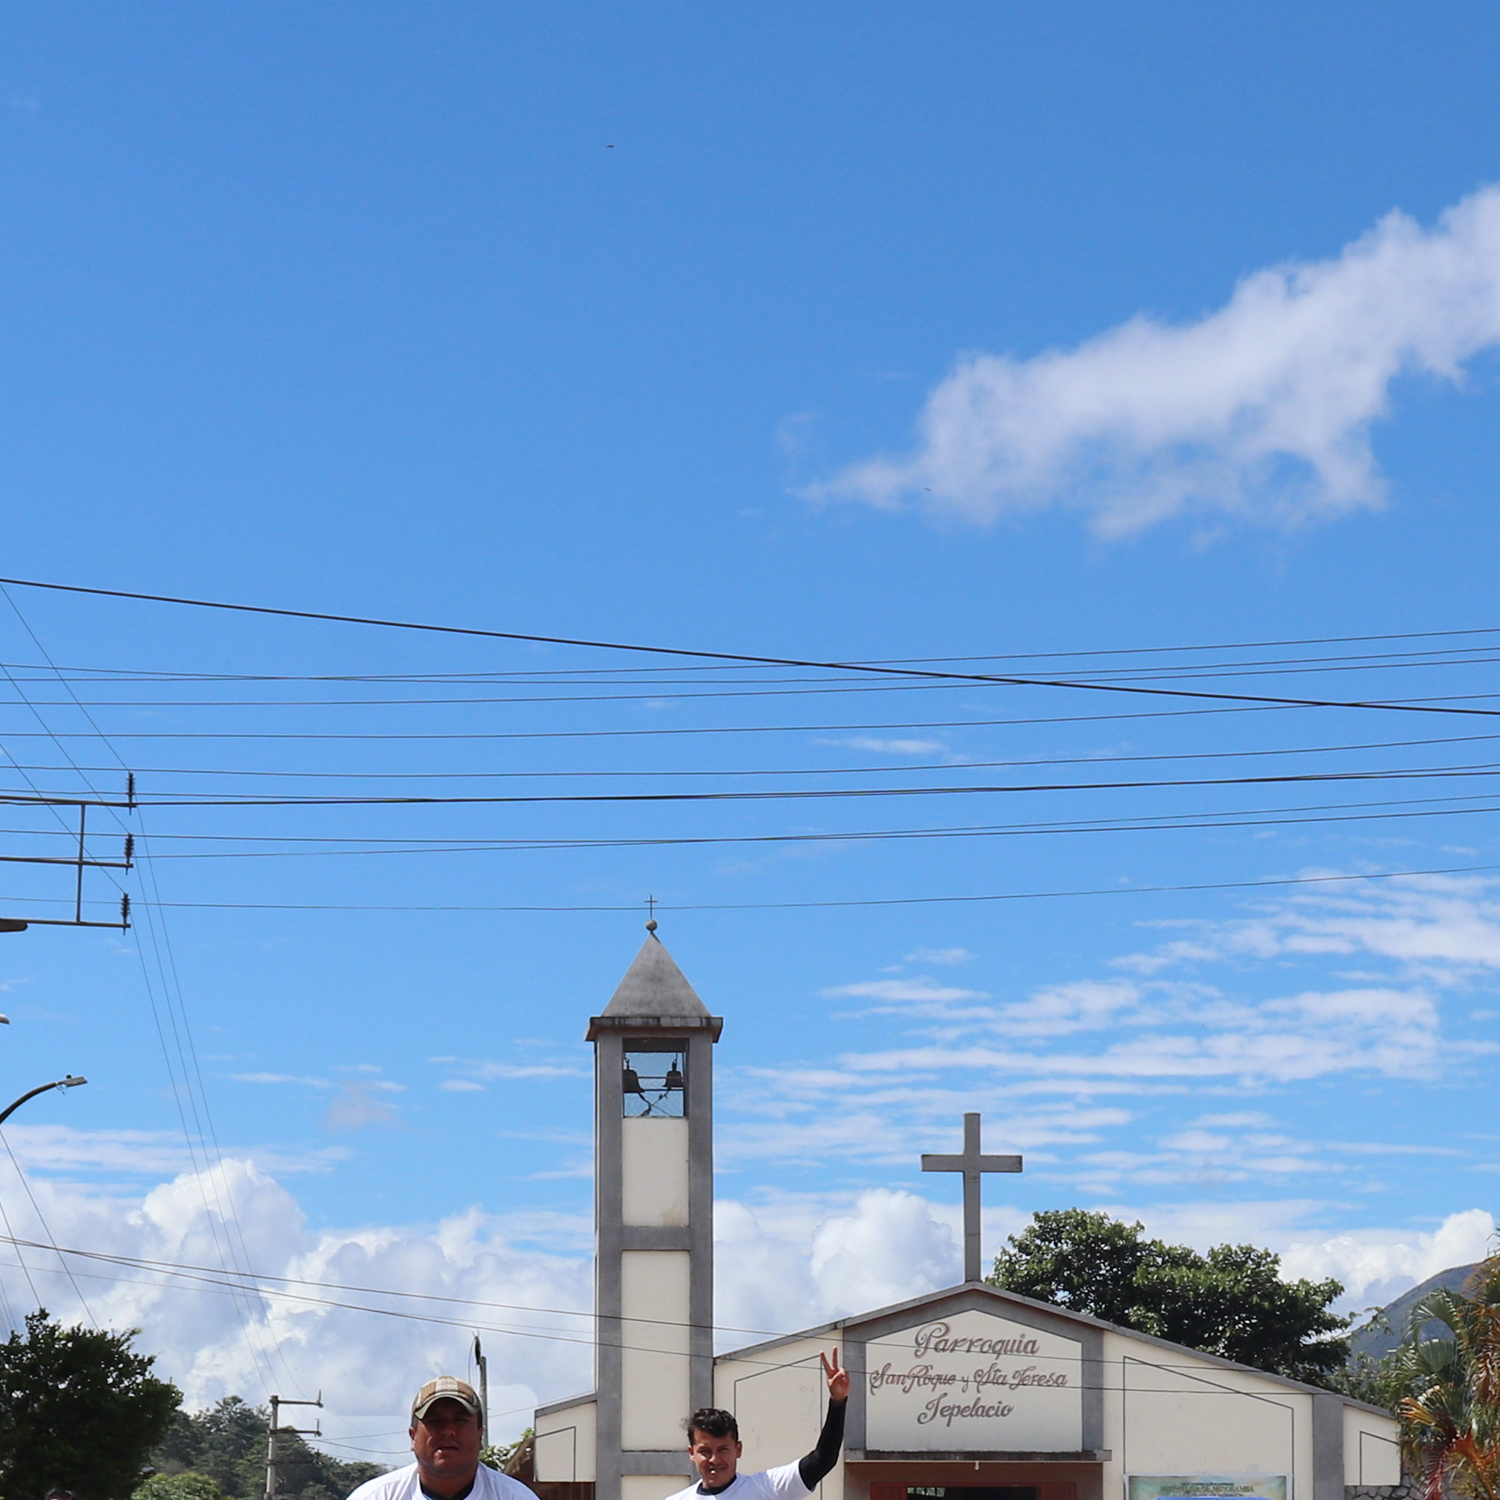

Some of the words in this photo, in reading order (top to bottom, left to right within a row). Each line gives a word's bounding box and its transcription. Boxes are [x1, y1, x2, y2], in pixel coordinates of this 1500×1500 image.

[913, 1321, 1041, 1360] Parroquia
[973, 1362, 1009, 1393] Sta
[1008, 1365, 1069, 1391] Teresa
